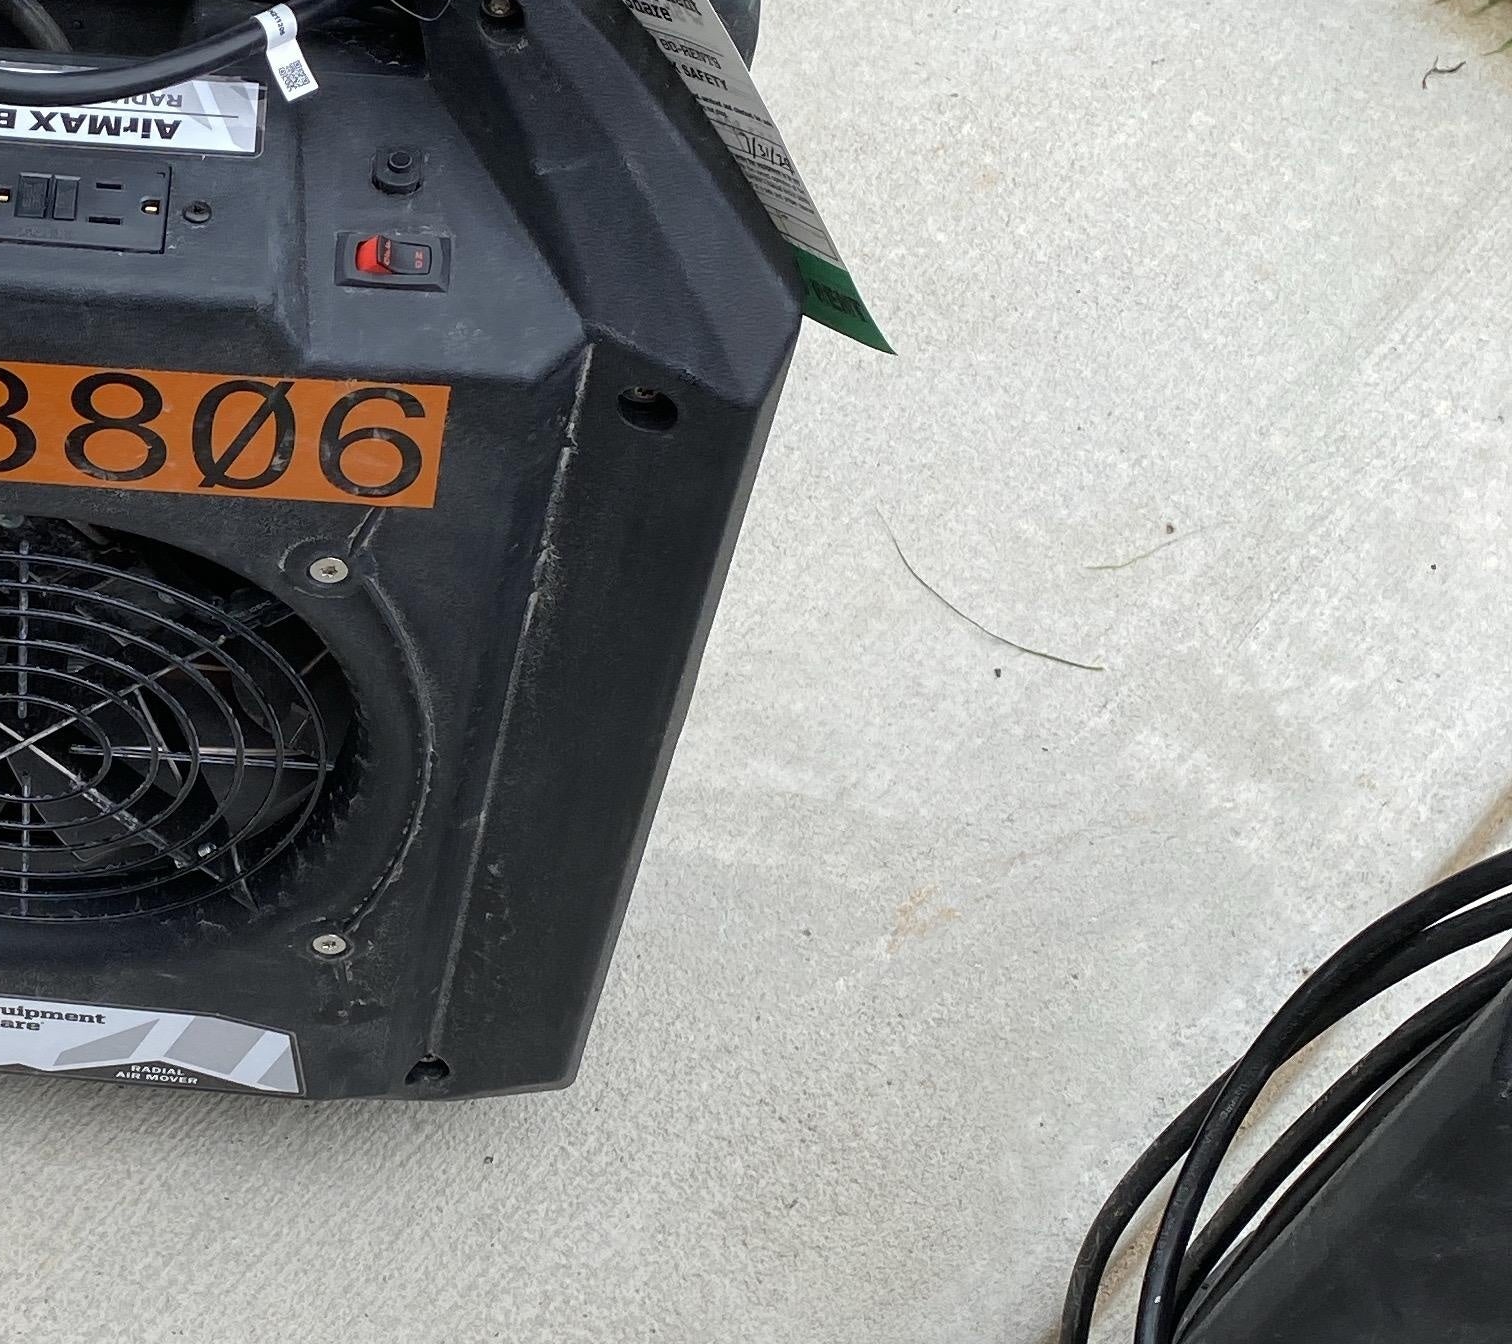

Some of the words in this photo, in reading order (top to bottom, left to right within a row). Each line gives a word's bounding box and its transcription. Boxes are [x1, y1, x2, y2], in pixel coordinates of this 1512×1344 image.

[28, 110, 183, 141] AirMAX
[115, 1069, 140, 1081] AIR
[142, 1072, 199, 1086] MOVER
[130, 1063, 186, 1078] RADIAL
